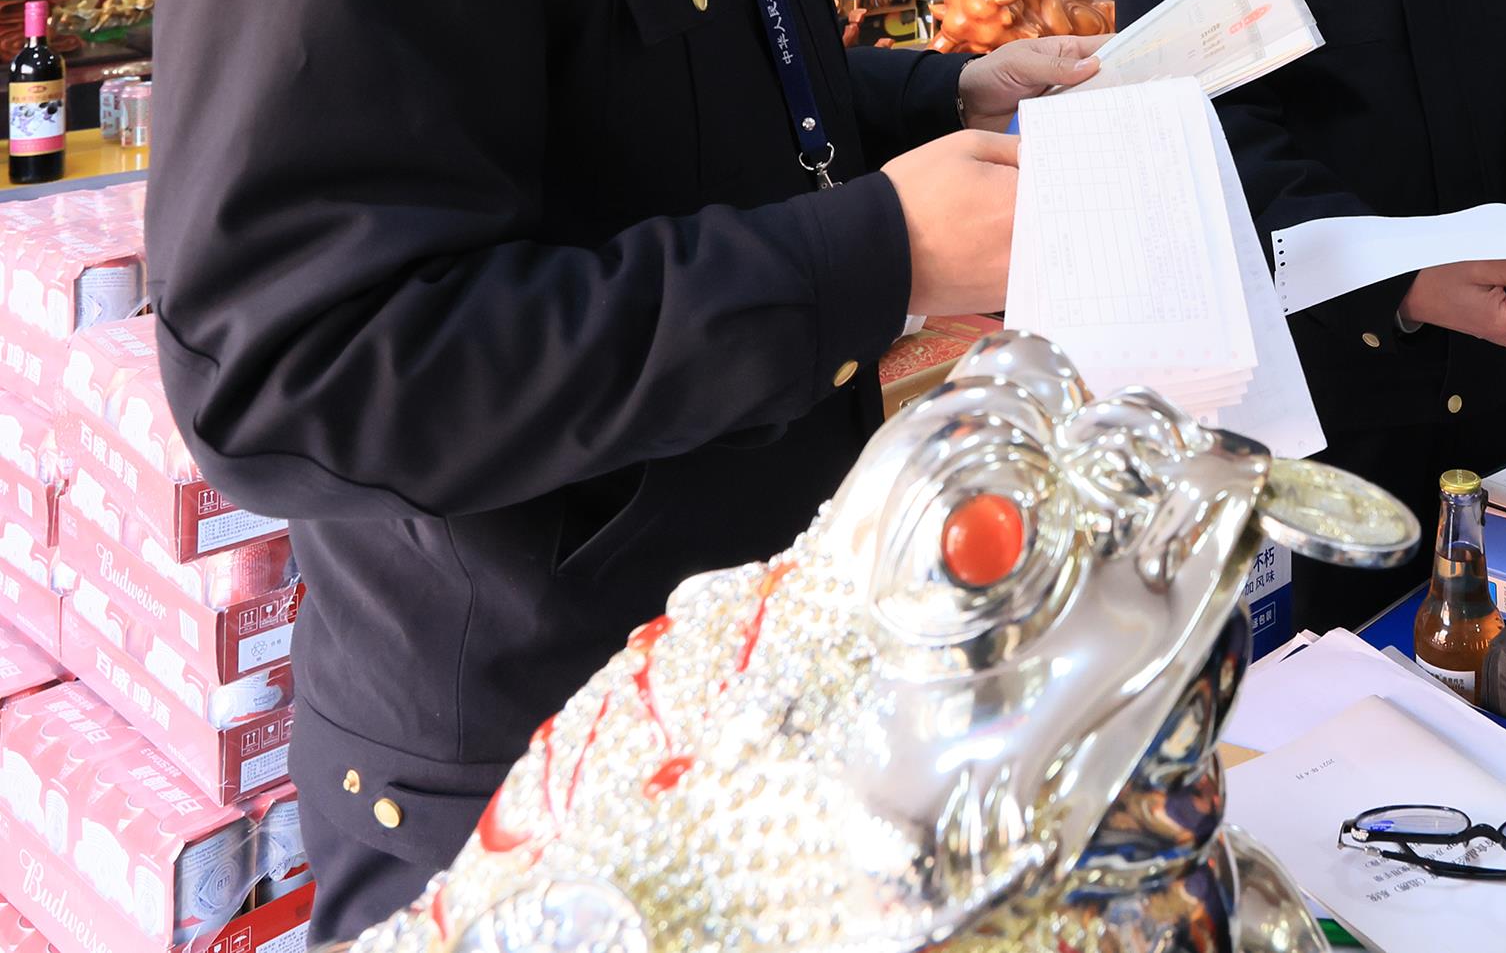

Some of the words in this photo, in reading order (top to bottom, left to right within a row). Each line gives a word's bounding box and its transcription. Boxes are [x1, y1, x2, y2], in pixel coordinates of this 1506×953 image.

[0, 335, 42, 386] 啤酒
[79, 421, 138, 494] 百威啤酒
[96, 542, 169, 620] Budweiser
[96, 646, 171, 731] 百威啤酒
